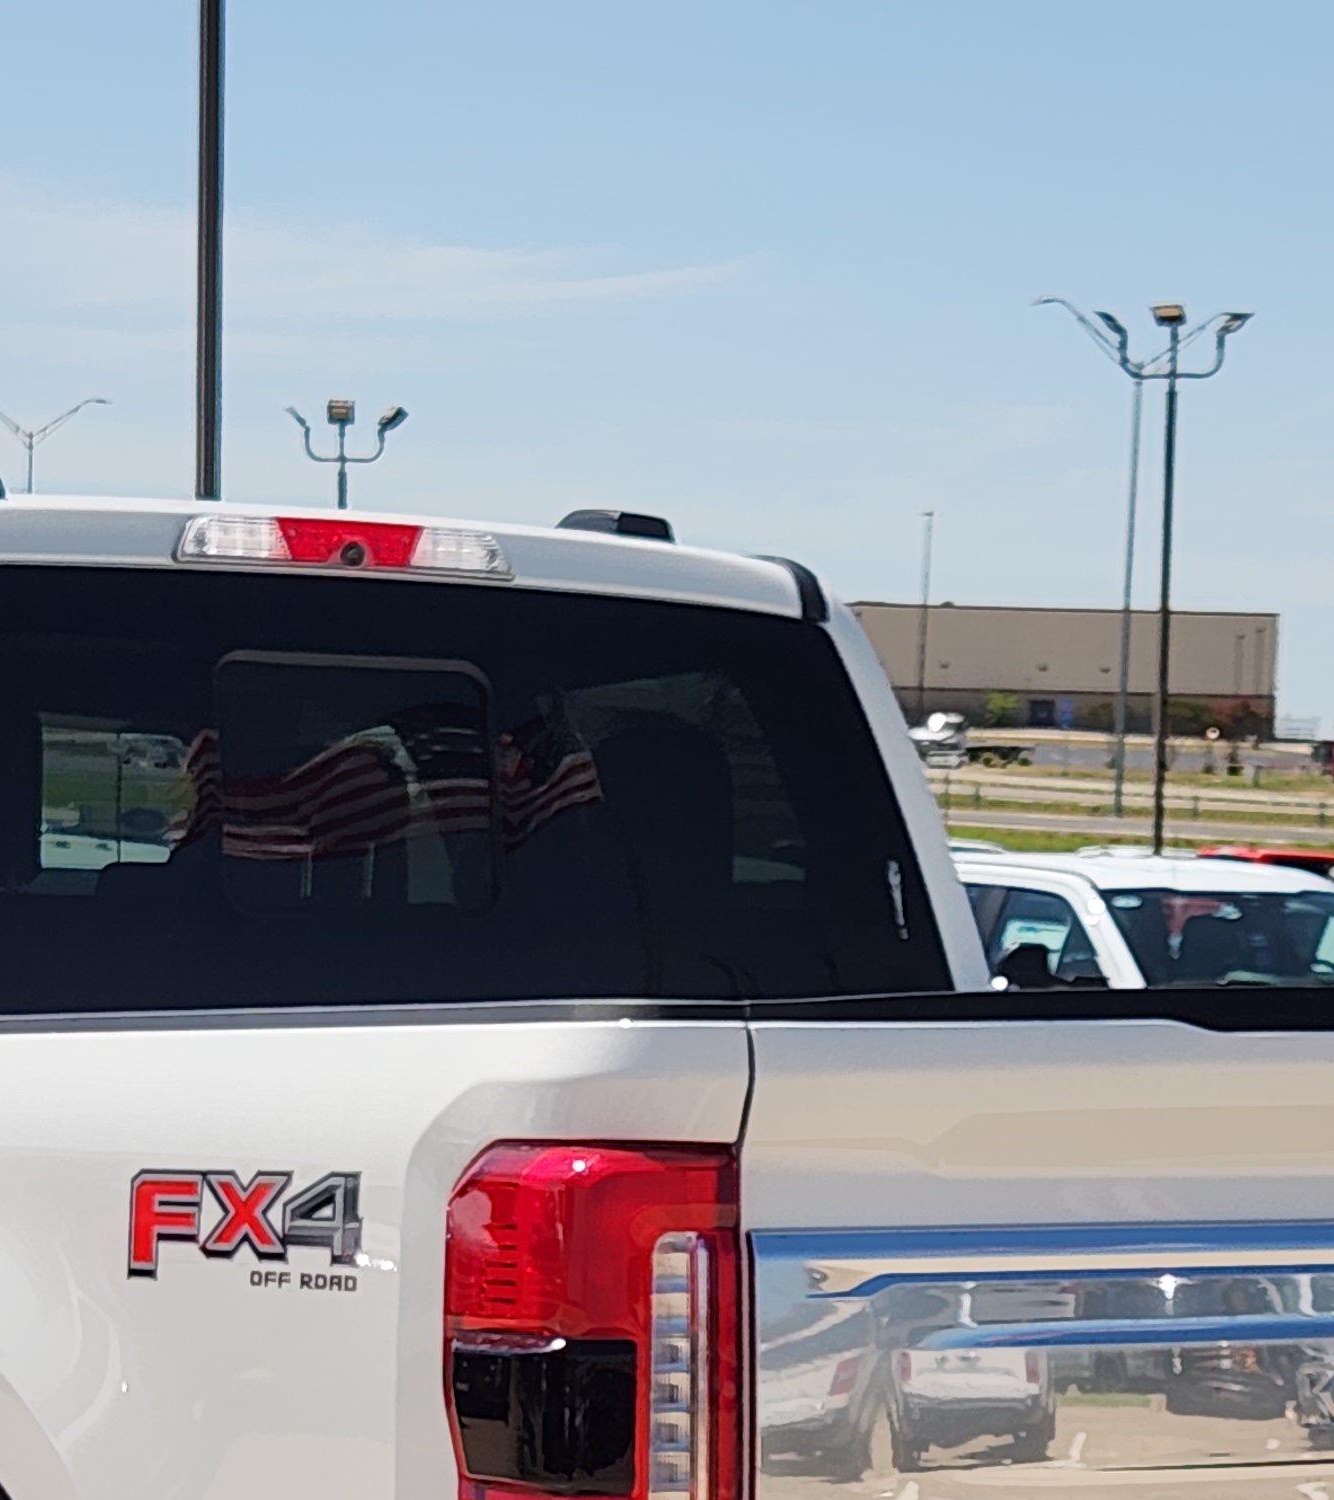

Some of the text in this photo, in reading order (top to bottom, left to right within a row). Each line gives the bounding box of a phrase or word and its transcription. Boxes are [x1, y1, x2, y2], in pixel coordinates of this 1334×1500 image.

[127, 1168, 363, 1281] FX4
[249, 1270, 357, 1292] OFF ROAD
